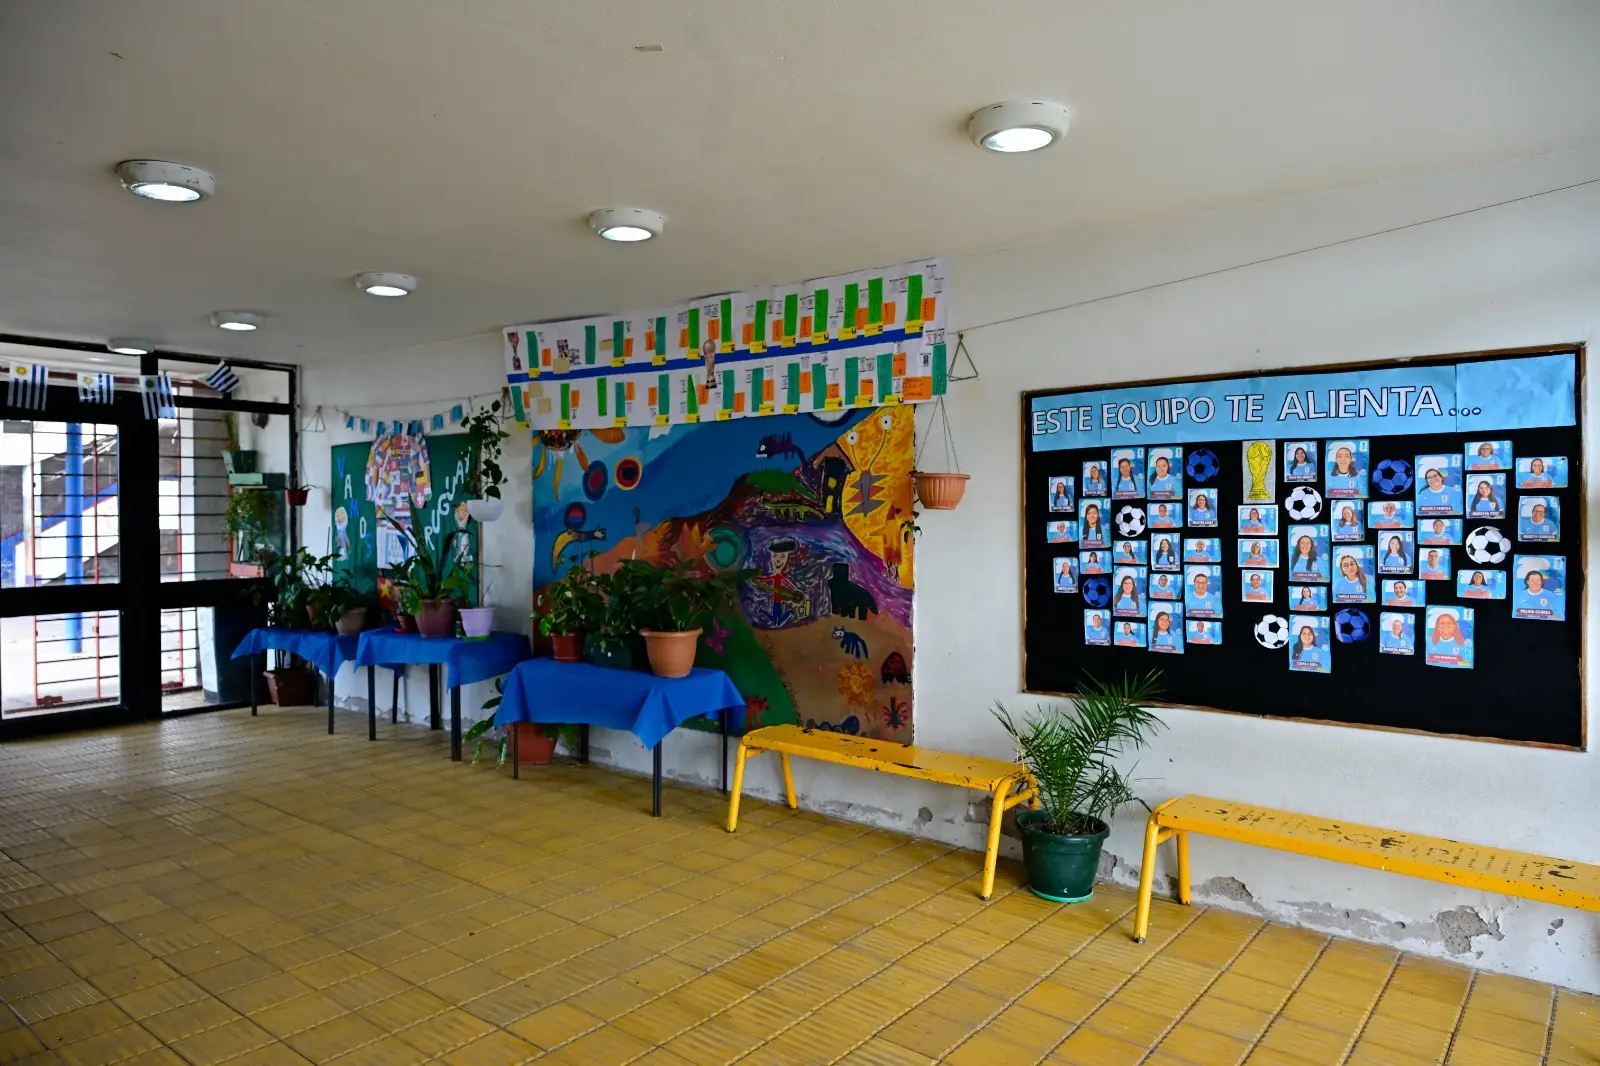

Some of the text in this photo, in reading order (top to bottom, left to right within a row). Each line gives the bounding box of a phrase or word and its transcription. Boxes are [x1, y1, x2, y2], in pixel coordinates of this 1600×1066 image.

[1032, 406, 1092, 435] ESTE
[1101, 397, 1215, 433] EQUIPO
[1225, 394, 1264, 422] TE
[337, 455, 372, 558] VAMOS
